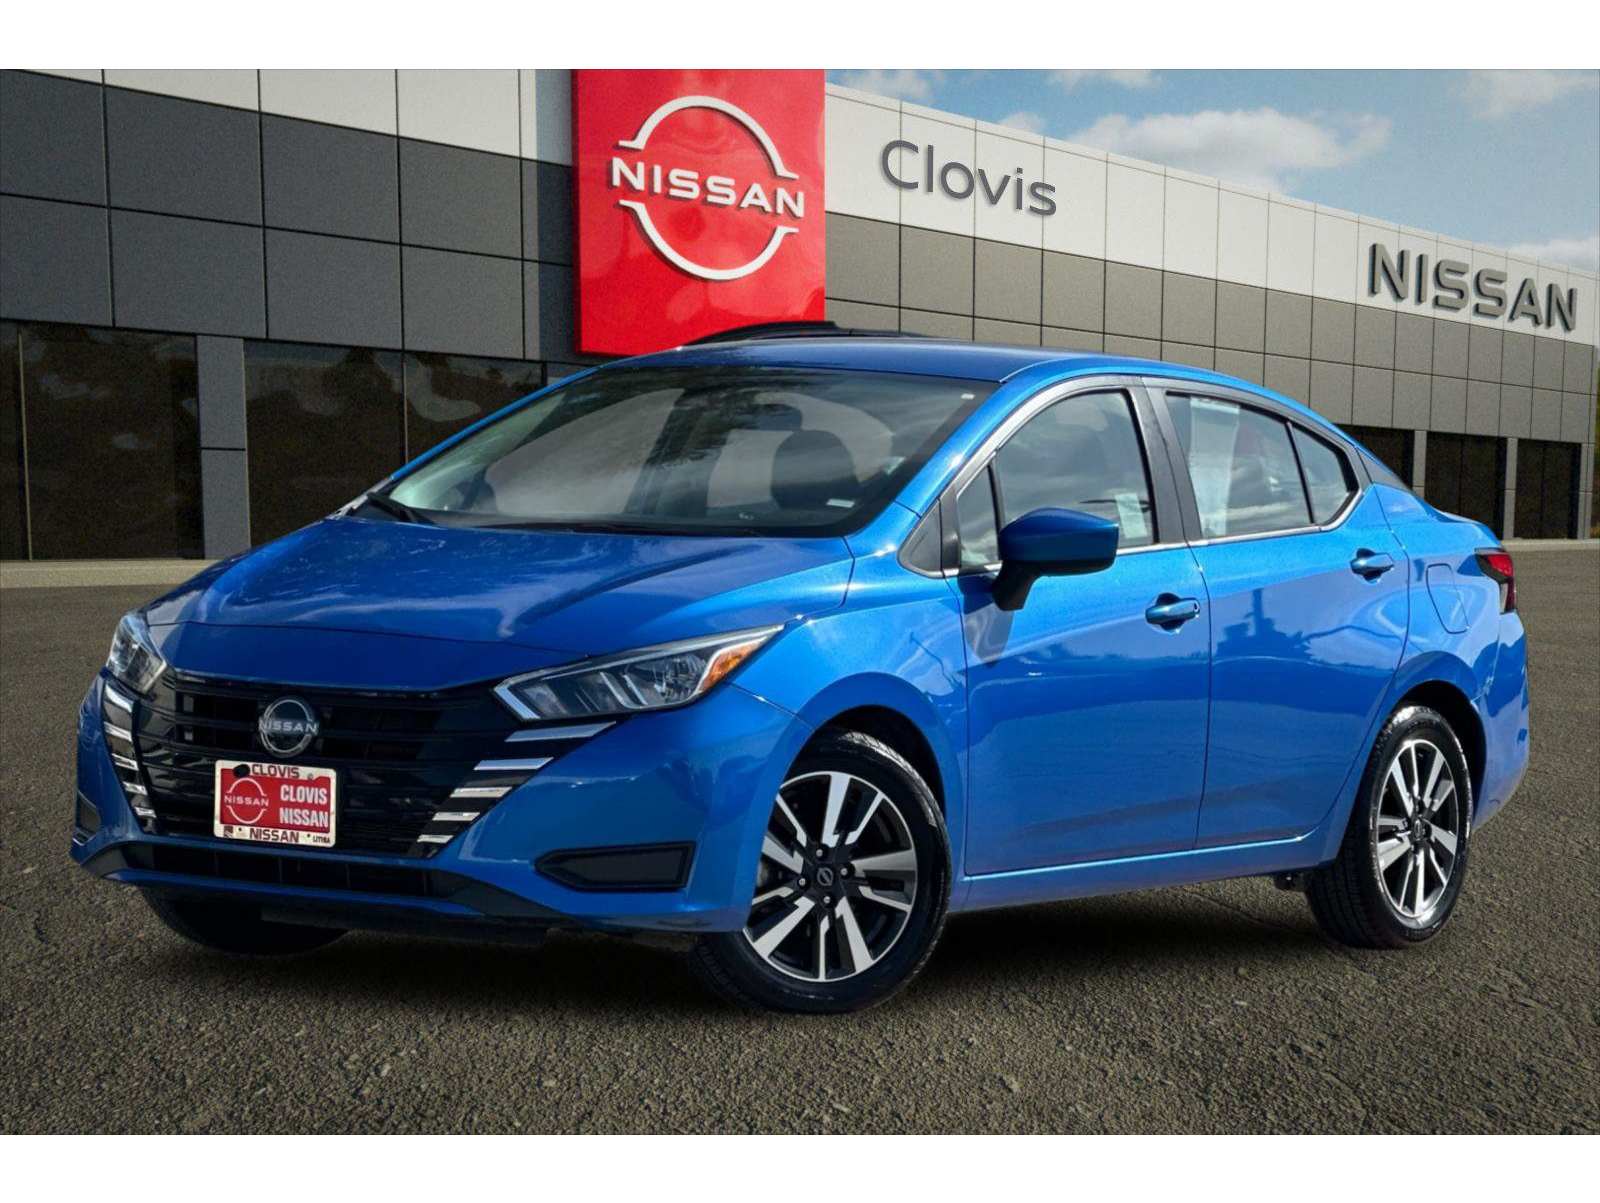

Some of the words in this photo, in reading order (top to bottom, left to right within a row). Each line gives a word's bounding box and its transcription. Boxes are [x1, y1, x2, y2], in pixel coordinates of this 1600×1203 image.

[612, 156, 804, 217] NISSAN
[882, 140, 1056, 215] Clovis
[1368, 243, 1577, 332] NISSAN
[259, 716, 318, 733] NISSAN
[252, 764, 300, 779] CLOVIS
[224, 795, 270, 807] NISSAN
[280, 785, 328, 805] CLOVIS
[279, 808, 328, 828] NISSAN
[249, 828, 299, 843] NISSAN
